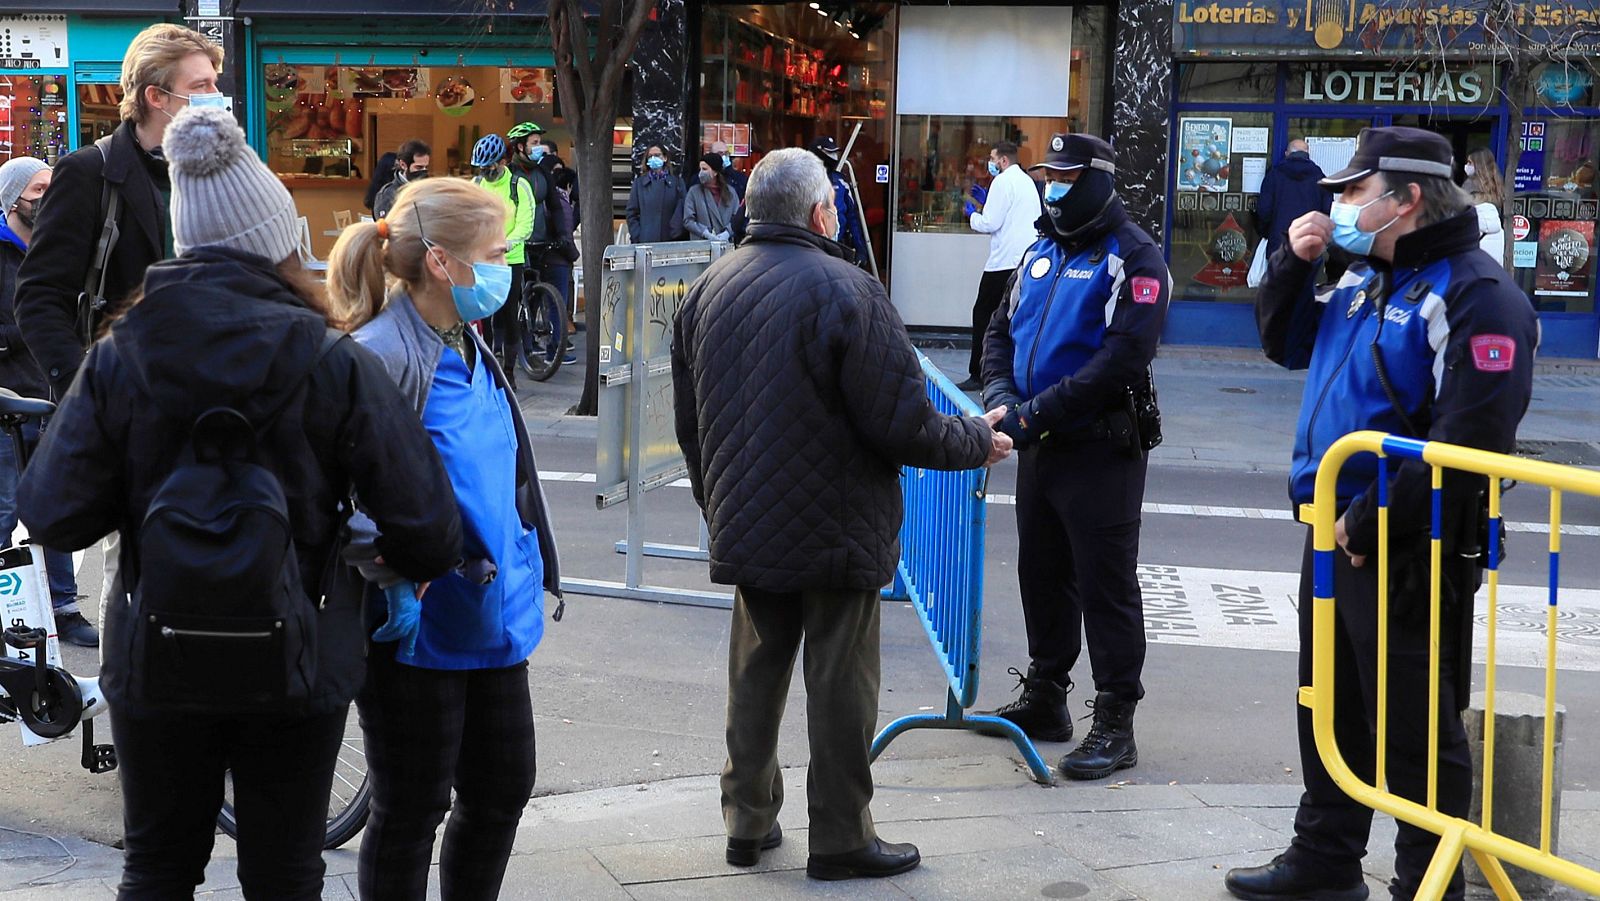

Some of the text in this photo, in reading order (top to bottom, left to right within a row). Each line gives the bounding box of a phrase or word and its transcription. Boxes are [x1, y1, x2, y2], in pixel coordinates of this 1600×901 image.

[1179, 1, 1279, 24] Loterías
[1303, 70, 1482, 103] LOTERIAS
[1516, 166, 1529, 174] erías
[1211, 583, 1278, 625] ZONA
